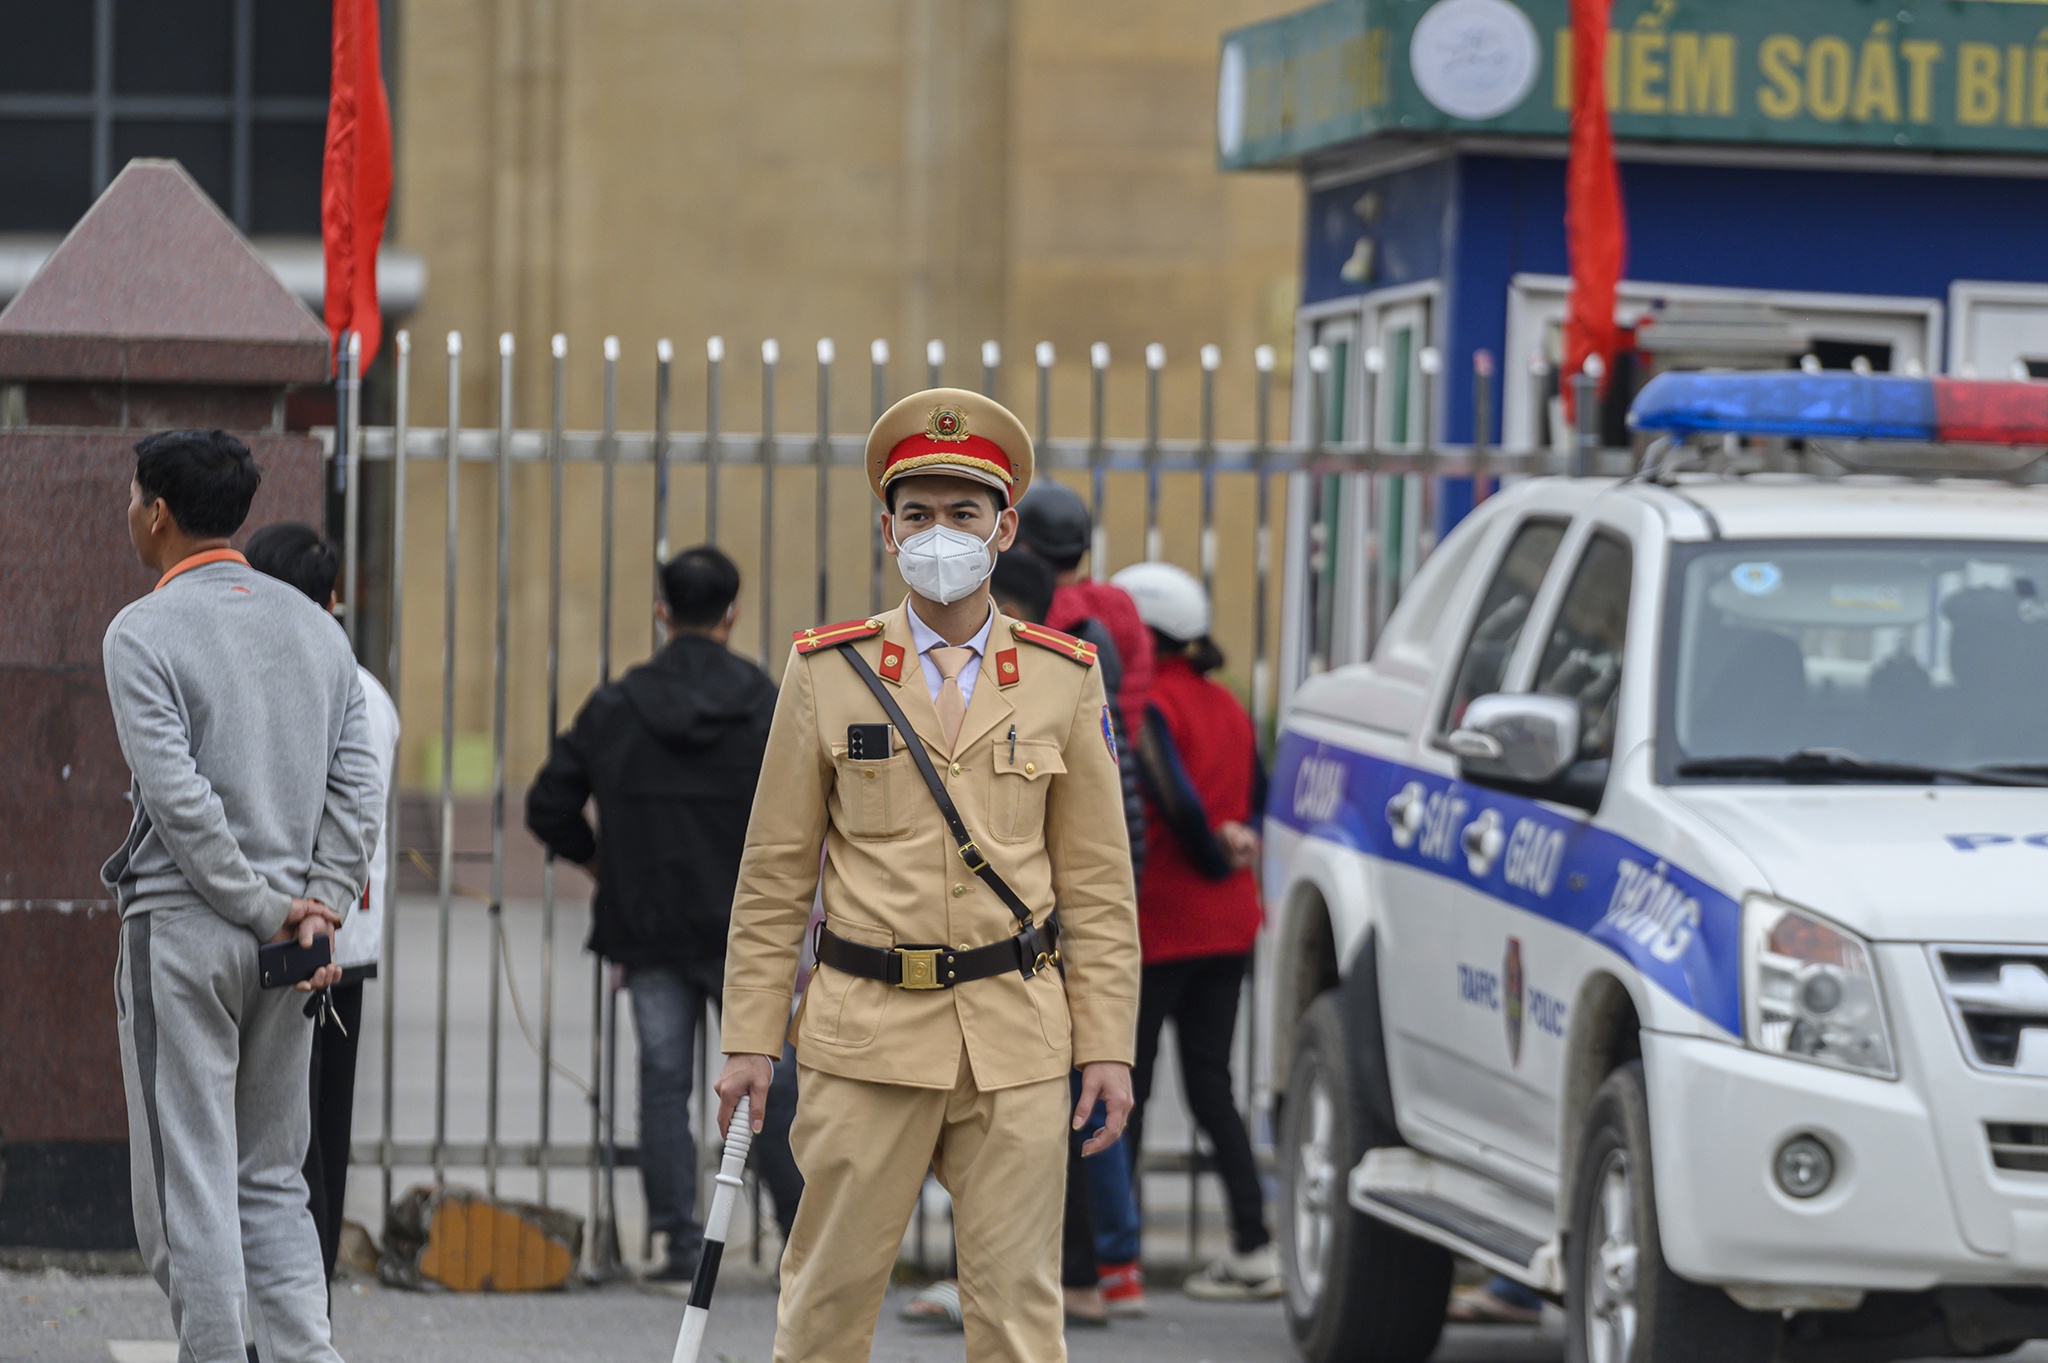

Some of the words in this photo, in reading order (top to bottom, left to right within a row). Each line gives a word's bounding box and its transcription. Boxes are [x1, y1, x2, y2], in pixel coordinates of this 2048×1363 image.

[1756, 18, 1943, 123] SOÁT
[1418, 780, 1470, 864] SÁT
[1504, 817, 1567, 898] GIAO
[1527, 985, 1566, 1037] POLIC
